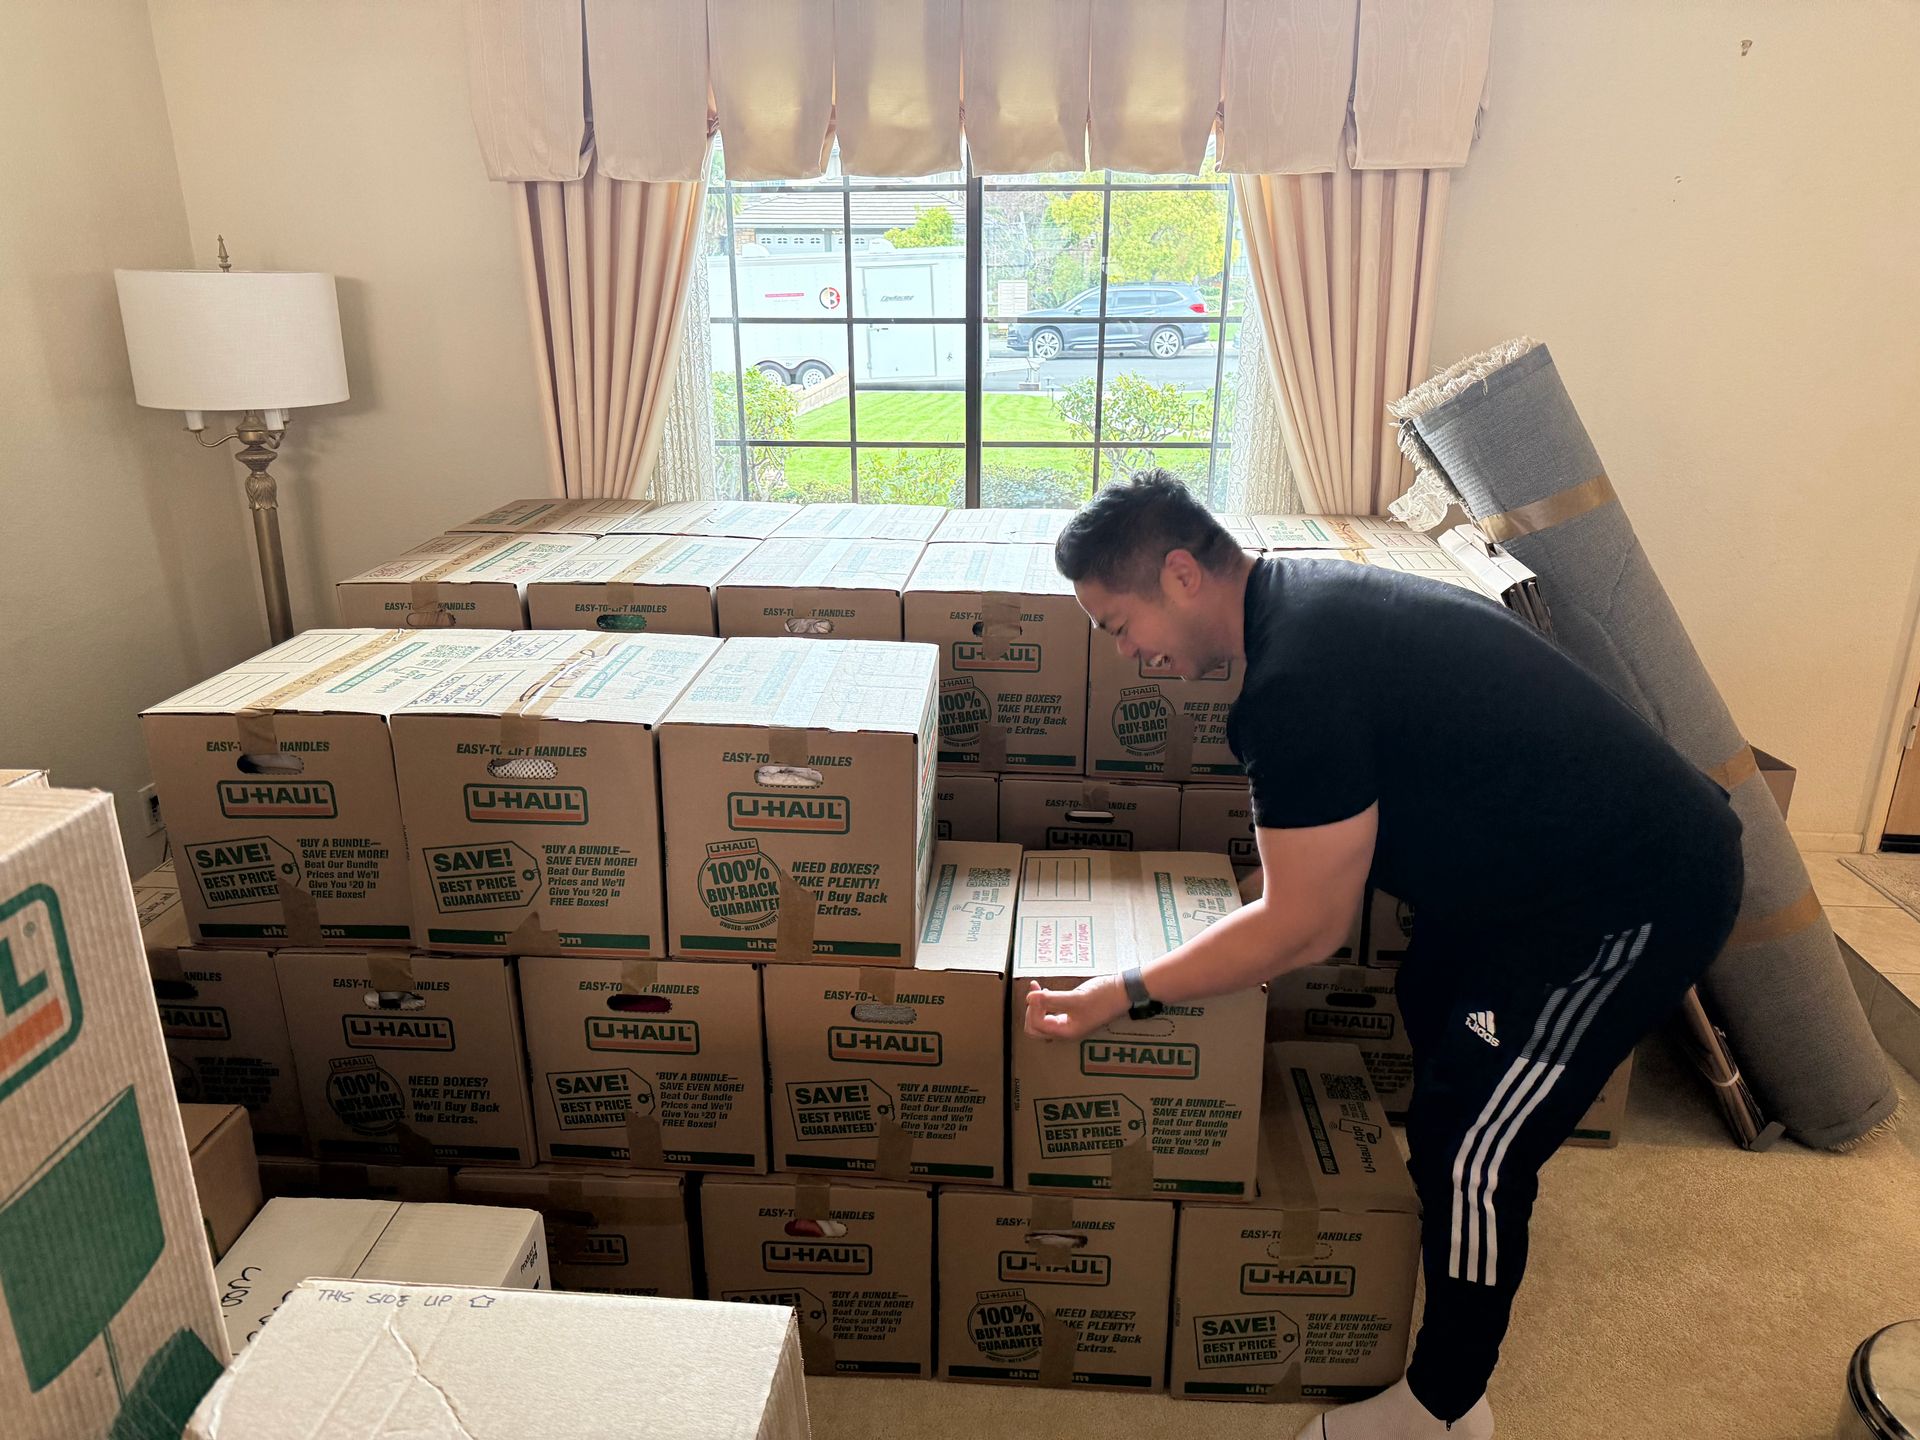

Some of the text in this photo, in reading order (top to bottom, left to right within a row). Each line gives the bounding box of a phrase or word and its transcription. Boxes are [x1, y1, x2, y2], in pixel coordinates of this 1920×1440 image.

[630, 604, 667, 613] HANDLES
[818, 608, 856, 618] HANDLES
[997, 692, 1062, 704] NEED BOXES?
[997, 704, 1061, 714] TAKE PLENTY!
[1120, 699, 1167, 721] 100%
[997, 714, 1067, 726] We'll Buy Back
[1015, 726, 1047, 735] Extras.
[280, 741, 329, 752] HANDLES
[534, 746, 587, 757] HANDLES
[226, 787, 328, 804] U-HAUL
[472, 790, 580, 810] U-HAUL
[736, 799, 842, 819] U-HAUL
[322, 838, 329, 847] A
[1052, 832, 1127, 847] U-HAUL
[570, 846, 576, 854] A
[709, 841, 755, 853] U-HAUL
[195, 843, 271, 869] SAVE!
[302, 849, 389, 859] SAVE EVEN MORE!
[433, 848, 513, 872] SAVE!
[304, 860, 378, 869] Beat Our Bundle
[546, 856, 638, 867] SAVE EVEN MORE!
[547, 867, 625, 877] Beat Our Bundle
[707, 857, 770, 885] 100%
[792, 861, 880, 875] NEED BOXES?
[203, 870, 277, 890] BEST PRICE
[306, 870, 379, 880] Prices and We'll
[309, 880, 328, 889] Give
[330, 880, 347, 889] You
[367, 880, 376, 889] in
[439, 876, 517, 893] BEST PRICE
[548, 877, 625, 887] Prices and We'll
[827, 877, 880, 889] PLENTY!
[311, 890, 366, 899] FREE Boxes!
[549, 887, 570, 896] Give
[572, 887, 590, 896] You
[611, 889, 620, 897] in
[704, 881, 779, 906] BUY-BACK
[827, 891, 888, 904] Buy Back
[550, 897, 609, 907] FREE Boxes!
[817, 904, 861, 916] Extras.
[974, 906, 985, 920] App
[651, 984, 700, 995] HANDLES
[896, 994, 945, 1005] HANDLES
[1310, 1014, 1389, 1031] U-HAUL
[350, 1020, 447, 1038] U-HAUL
[593, 1022, 692, 1042] U-HAUL
[836, 1032, 935, 1053] U-HAUL
[1088, 1045, 1192, 1065] U-HAUL
[333, 1072, 389, 1097] 100%
[408, 1075, 488, 1087] NEED BOXES?
[555, 1074, 629, 1095] SAVE!
[659, 1082, 744, 1092] SAVE EVEN MORE!
[411, 1088, 490, 1100] TAKE PLENTY!
[660, 1091, 733, 1101] Beat Our Bundle
[795, 1085, 869, 1105] SAVE!
[900, 1093, 986, 1104] SAVE EVEN MORE!
[413, 1100, 500, 1113] We'll Buy Back
[560, 1099, 632, 1113] BEST PRICE
[661, 1101, 732, 1111] Prices and We'll
[942, 1104, 973, 1113] Bundle
[1043, 1100, 1120, 1121] SAVE!
[415, 1112, 478, 1124] the Extras.
[661, 1110, 681, 1118] Give
[684, 1110, 699, 1119] You
[798, 1110, 871, 1124] BEST PRICE
[900, 1112, 928, 1121] Prices
[1152, 1108, 1242, 1119] SAVE EVEN MORE!
[662, 1119, 717, 1128] FREE Boxes!
[926, 1131, 956, 1140] Boxes!
[1045, 1126, 1122, 1141] BEST PRICE
[1353, 1125, 1367, 1142] App
[828, 1210, 875, 1220] HANDLES
[770, 1246, 865, 1263] U-HAUL
[1249, 1269, 1347, 1285] U-HAUL
[318, 1289, 453, 1308] THIS SIDE UP
[976, 1304, 1034, 1326] 100%
[1054, 1308, 1136, 1320] NEED BOXES?
[975, 1323, 1042, 1340] BUY-BACK
[1087, 1321, 1136, 1332] PLENTY!
[1202, 1316, 1276, 1336] SAVE!
[1086, 1332, 1142, 1344] Buy Back
[1076, 1342, 1117, 1353] Extras.
[1203, 1339, 1276, 1354] BEST PRICE
